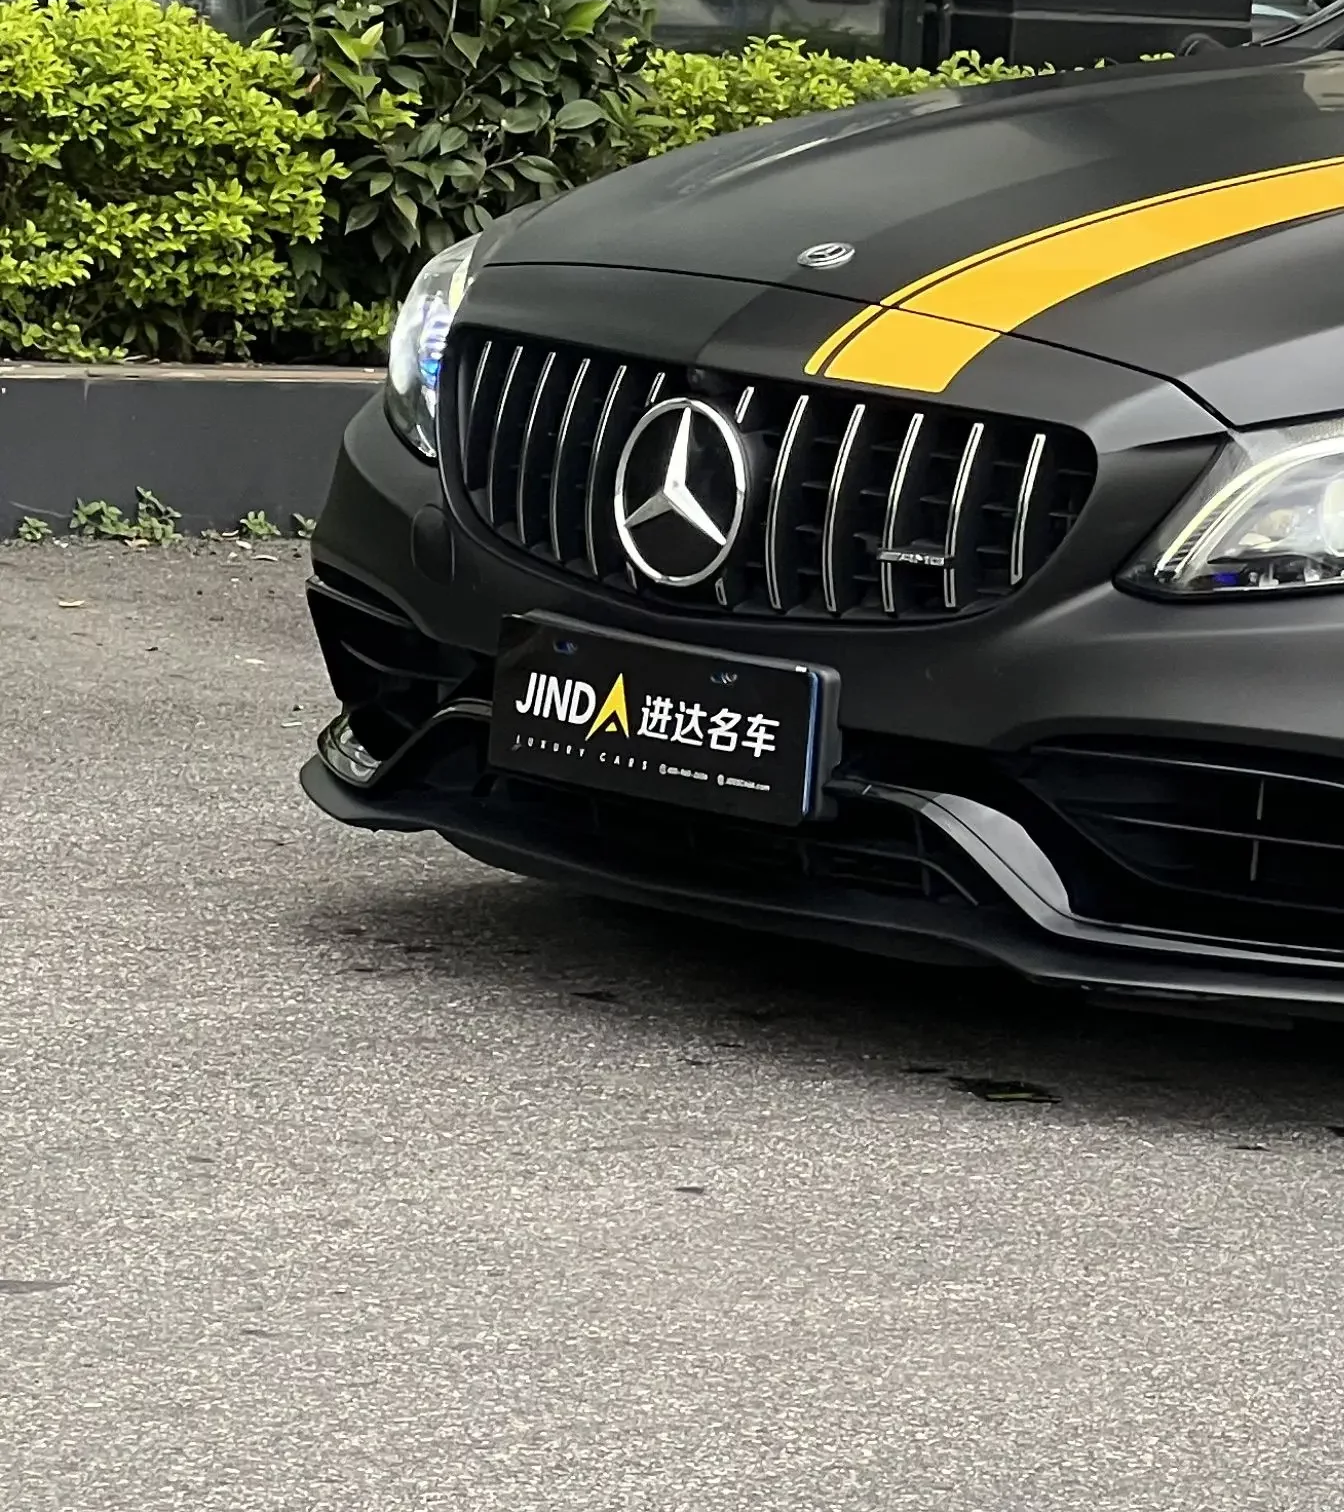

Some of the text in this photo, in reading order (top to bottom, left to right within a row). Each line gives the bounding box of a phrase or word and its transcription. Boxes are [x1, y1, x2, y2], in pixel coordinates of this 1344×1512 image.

[514, 672, 780, 758] JINDA 进达名车
